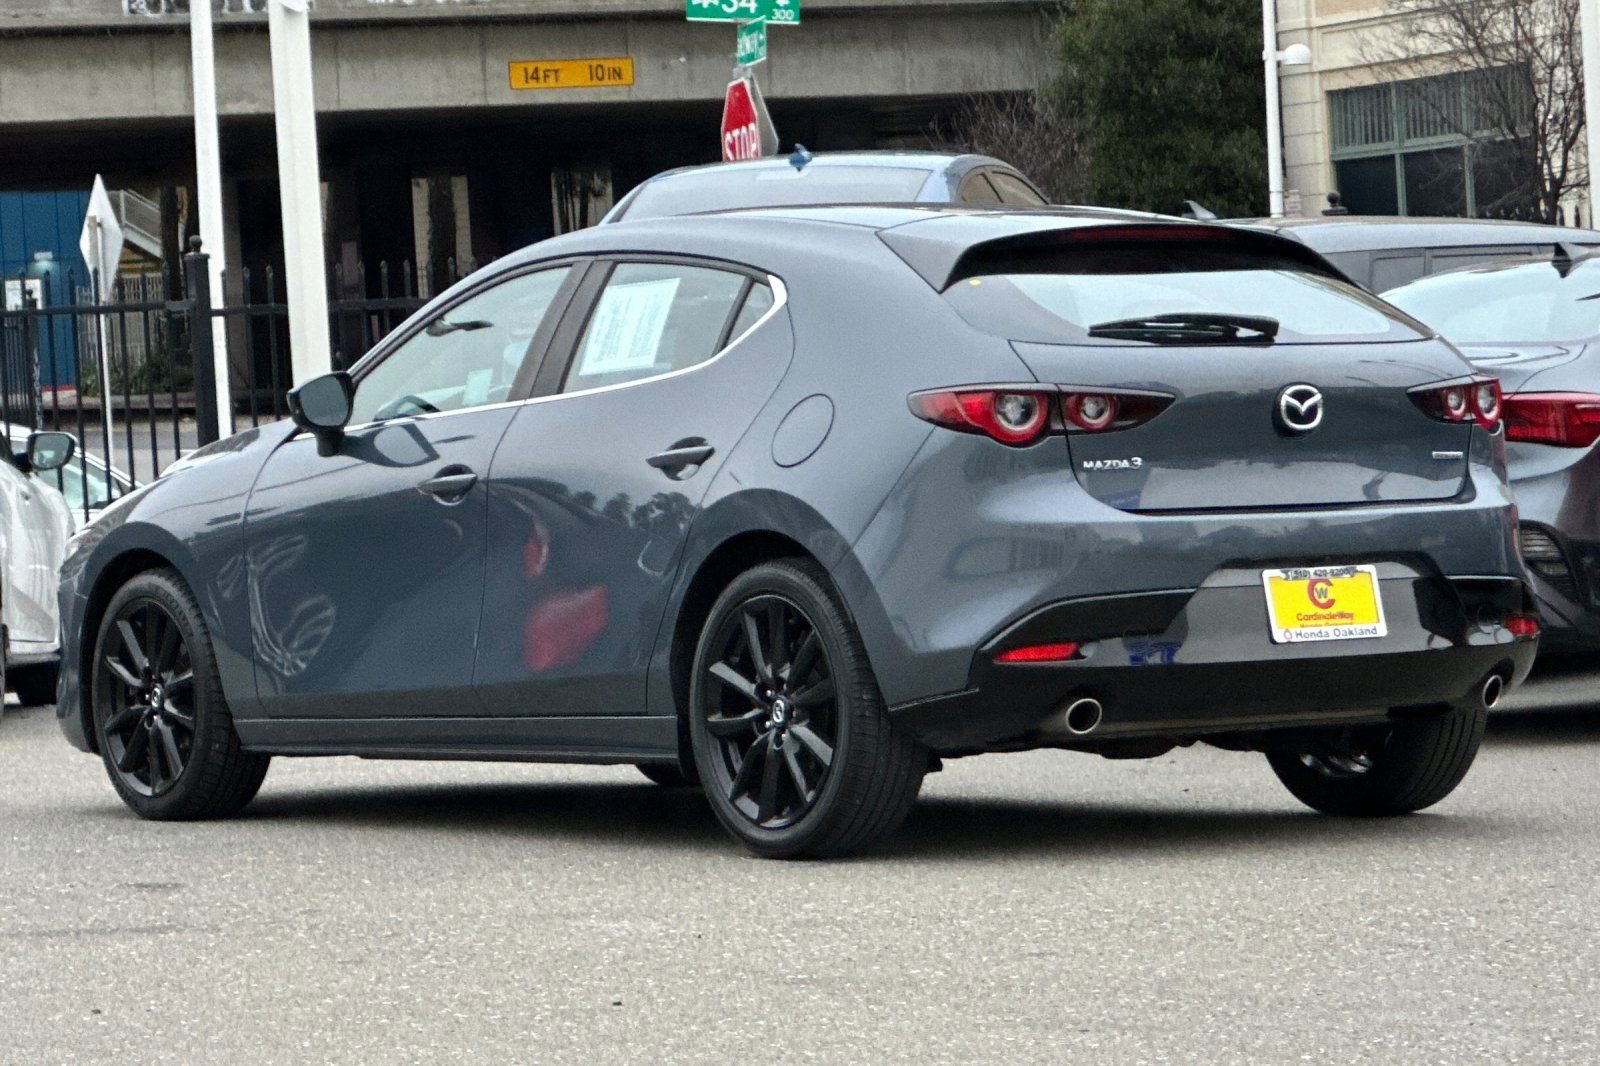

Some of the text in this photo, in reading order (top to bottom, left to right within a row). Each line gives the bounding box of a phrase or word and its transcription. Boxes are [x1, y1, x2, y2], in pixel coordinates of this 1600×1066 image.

[771, 8, 795, 20] 300
[724, 122, 757, 161] STOP
[1295, 625, 1378, 639] Honda Oakland
